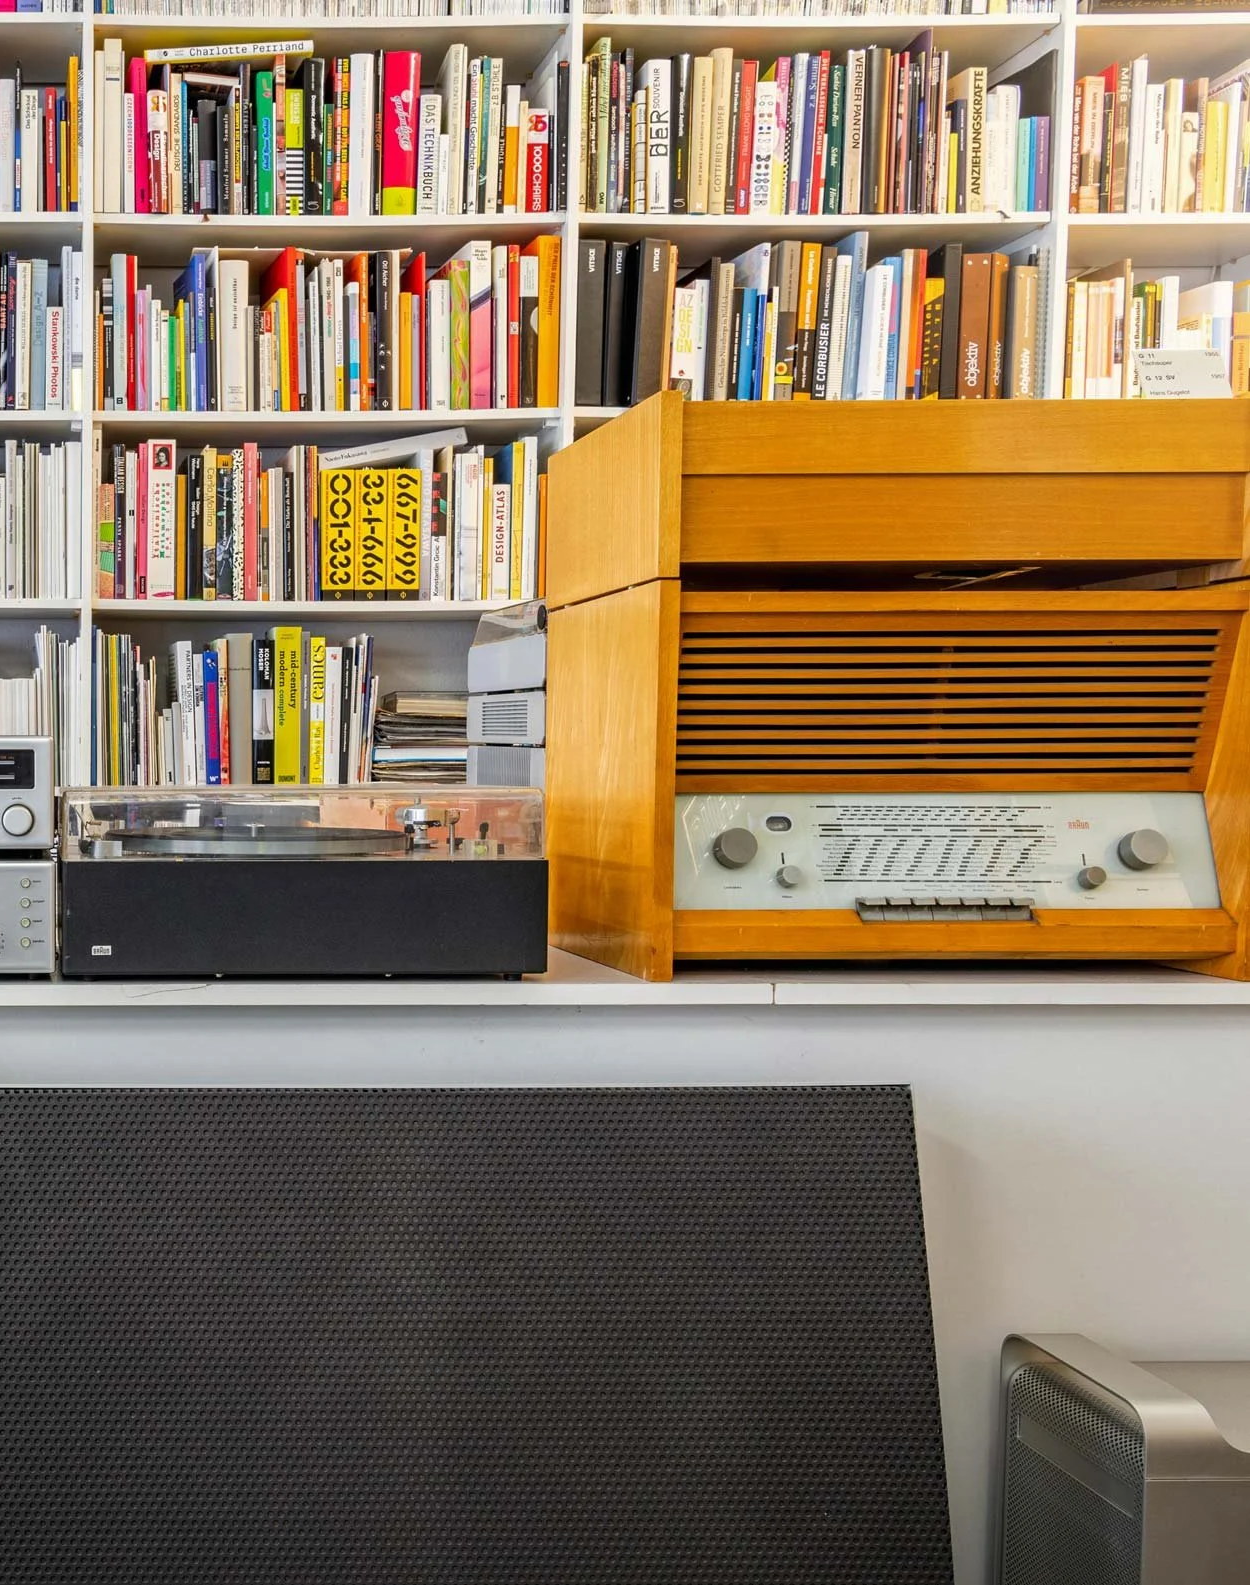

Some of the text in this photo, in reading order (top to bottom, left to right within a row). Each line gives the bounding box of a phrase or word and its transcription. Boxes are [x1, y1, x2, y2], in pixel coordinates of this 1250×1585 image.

[189, 45, 247, 57] Charlotte
[253, 41, 304, 53] Perriand
[492, 63, 501, 92] STÜHLE
[652, 68, 661, 109] SOUVENIR
[1120, 67, 1129, 102] MIES
[852, 57, 864, 150] VERNER PANTON
[153, 133, 161, 161] Design
[421, 104, 436, 199] DAS TECHNIKBUCH
[468, 126, 477, 171] Geschichte
[713, 105, 725, 193] GOTTFRIED SEMPER
[815, 125, 824, 156] SCHUHE
[971, 70, 984, 196] ANZIEHUNGSKRÄFTE
[1073, 124, 1081, 136] der
[532, 145, 543, 211] 1000 CHAIRS
[50, 311, 60, 398] Stankowski Photos
[815, 322, 830, 397] LE CORBUSIER
[966, 341, 979, 387] objektiv
[993, 340, 1002, 386] objektiv
[1021, 348, 1030, 394] objektiv
[117, 456, 125, 494] ITALIAN DESIGN
[206, 467, 215, 527] Carlo Mollino
[329, 473, 352, 586] 001-333
[361, 474, 385, 586] 334-666
[395, 473, 418, 586] 667-999
[494, 490, 505, 563] DESIGN-ATLAS
[432, 563, 440, 597] Konstantin
[278, 650, 287, 727] modern complete
[288, 650, 299, 709] mid-century
[311, 645, 324, 700] eames
[184, 689, 192, 713] DESIGN
[313, 726, 322, 770] Charles Ray
[278, 774, 296, 783] DUMONT
[1067, 819, 1090, 829] BRAUN
[92, 947, 110, 955] BRAUN
